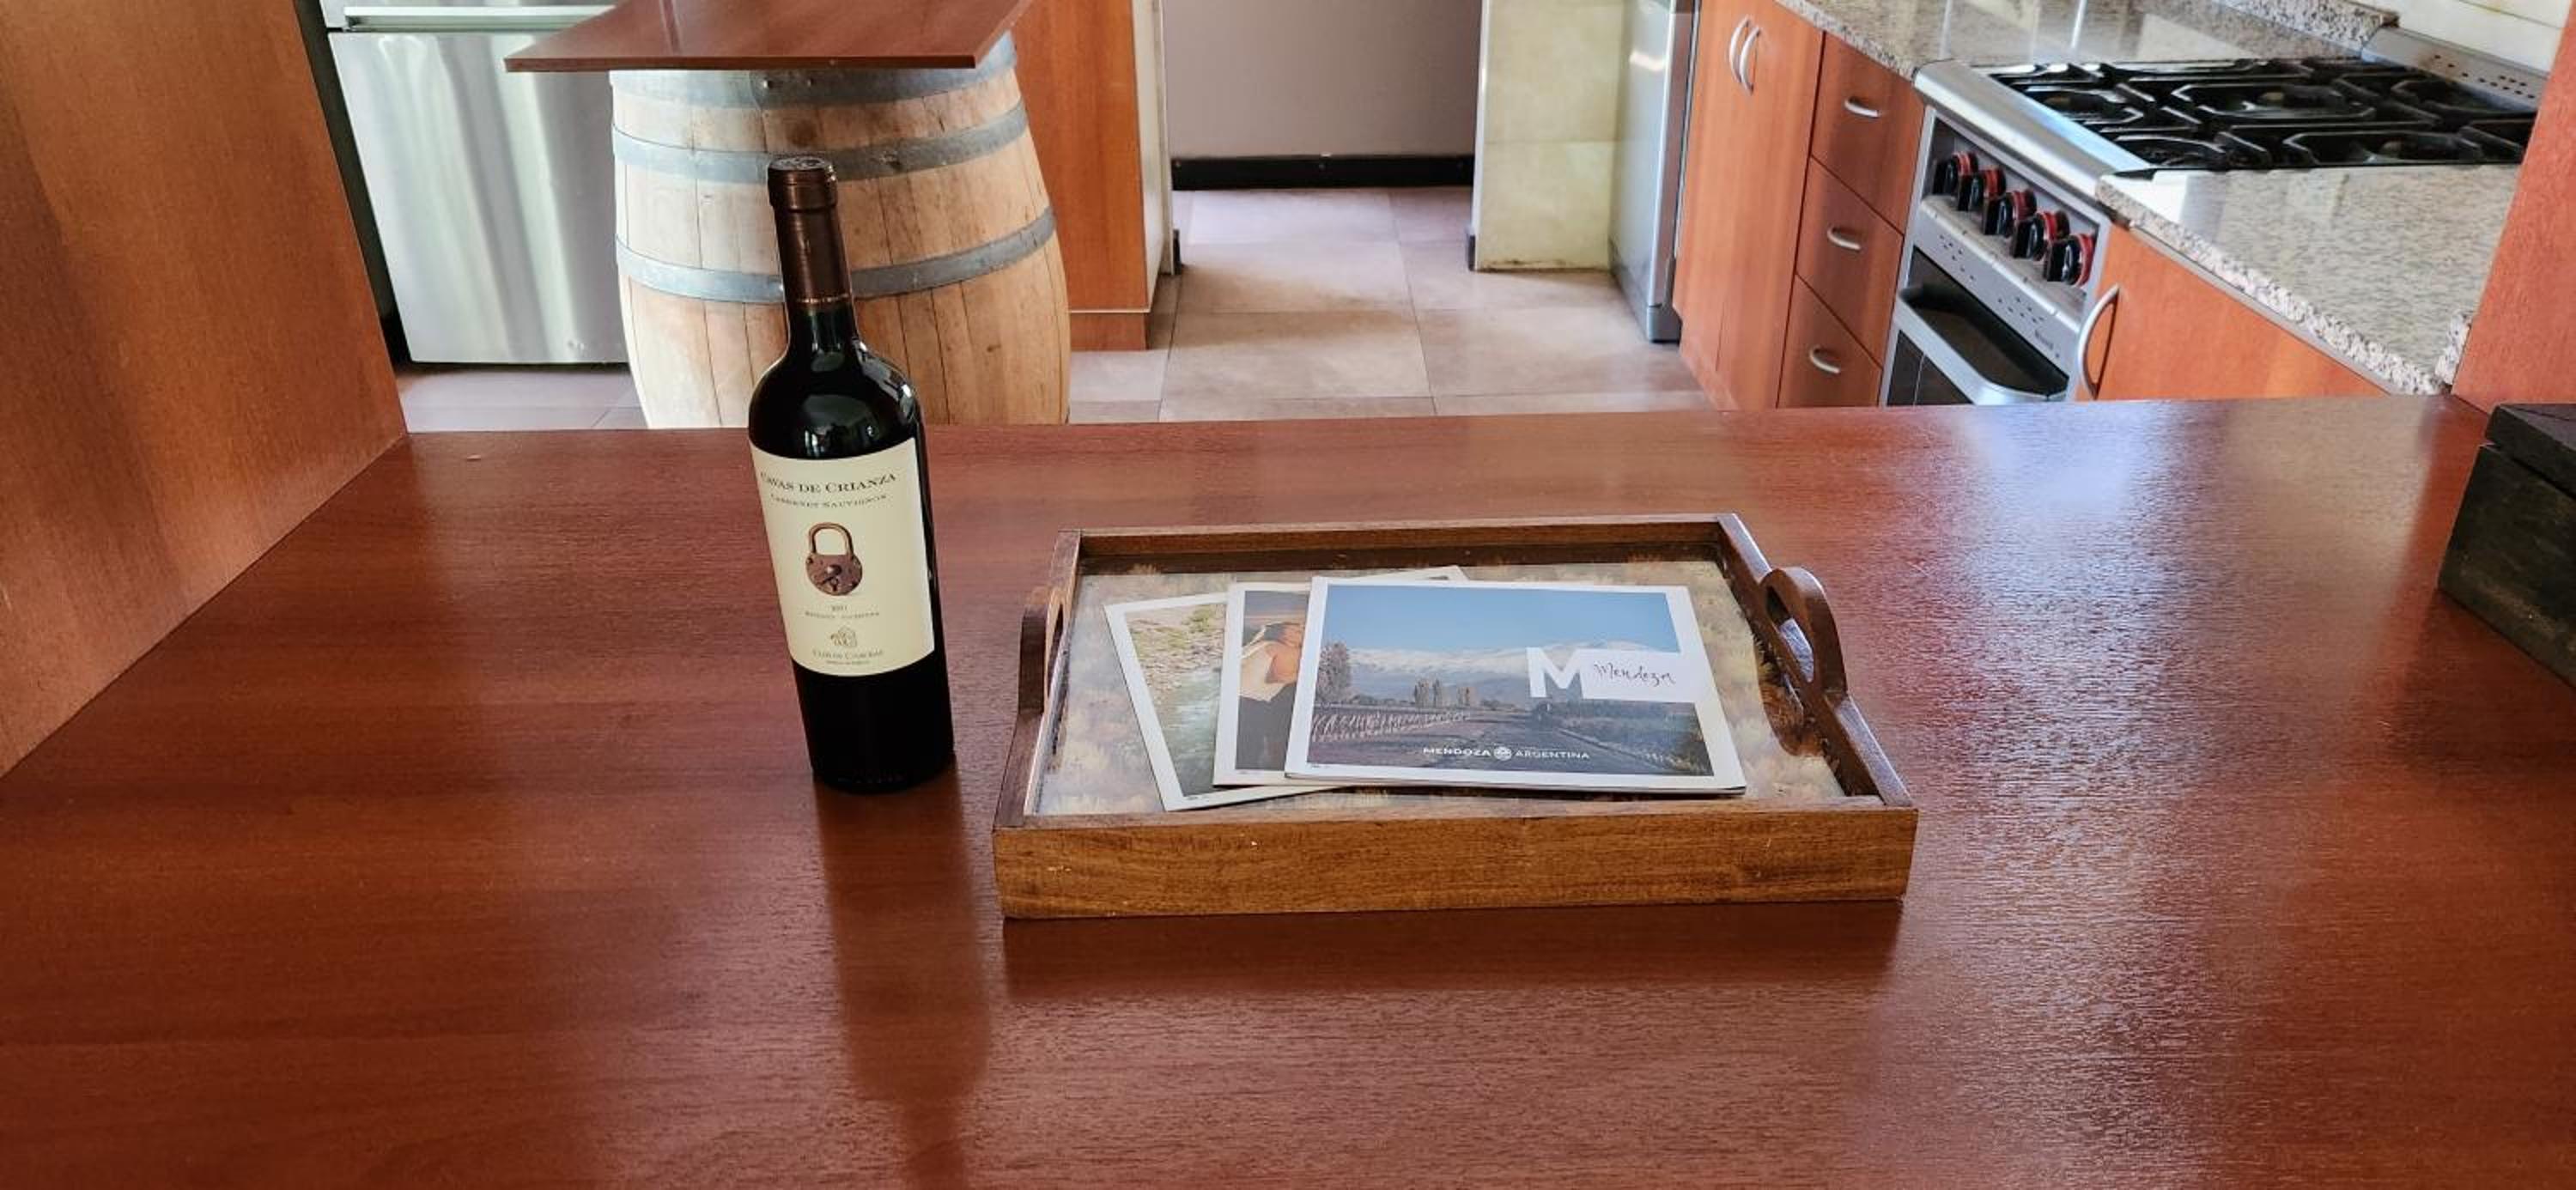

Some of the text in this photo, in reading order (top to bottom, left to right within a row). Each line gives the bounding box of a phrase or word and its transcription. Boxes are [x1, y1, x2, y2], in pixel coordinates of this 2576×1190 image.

[799, 483, 822, 494] DE
[825, 473, 896, 494] CRIANZA
[1422, 747, 1590, 760] MENDOZA ARGENTINA
